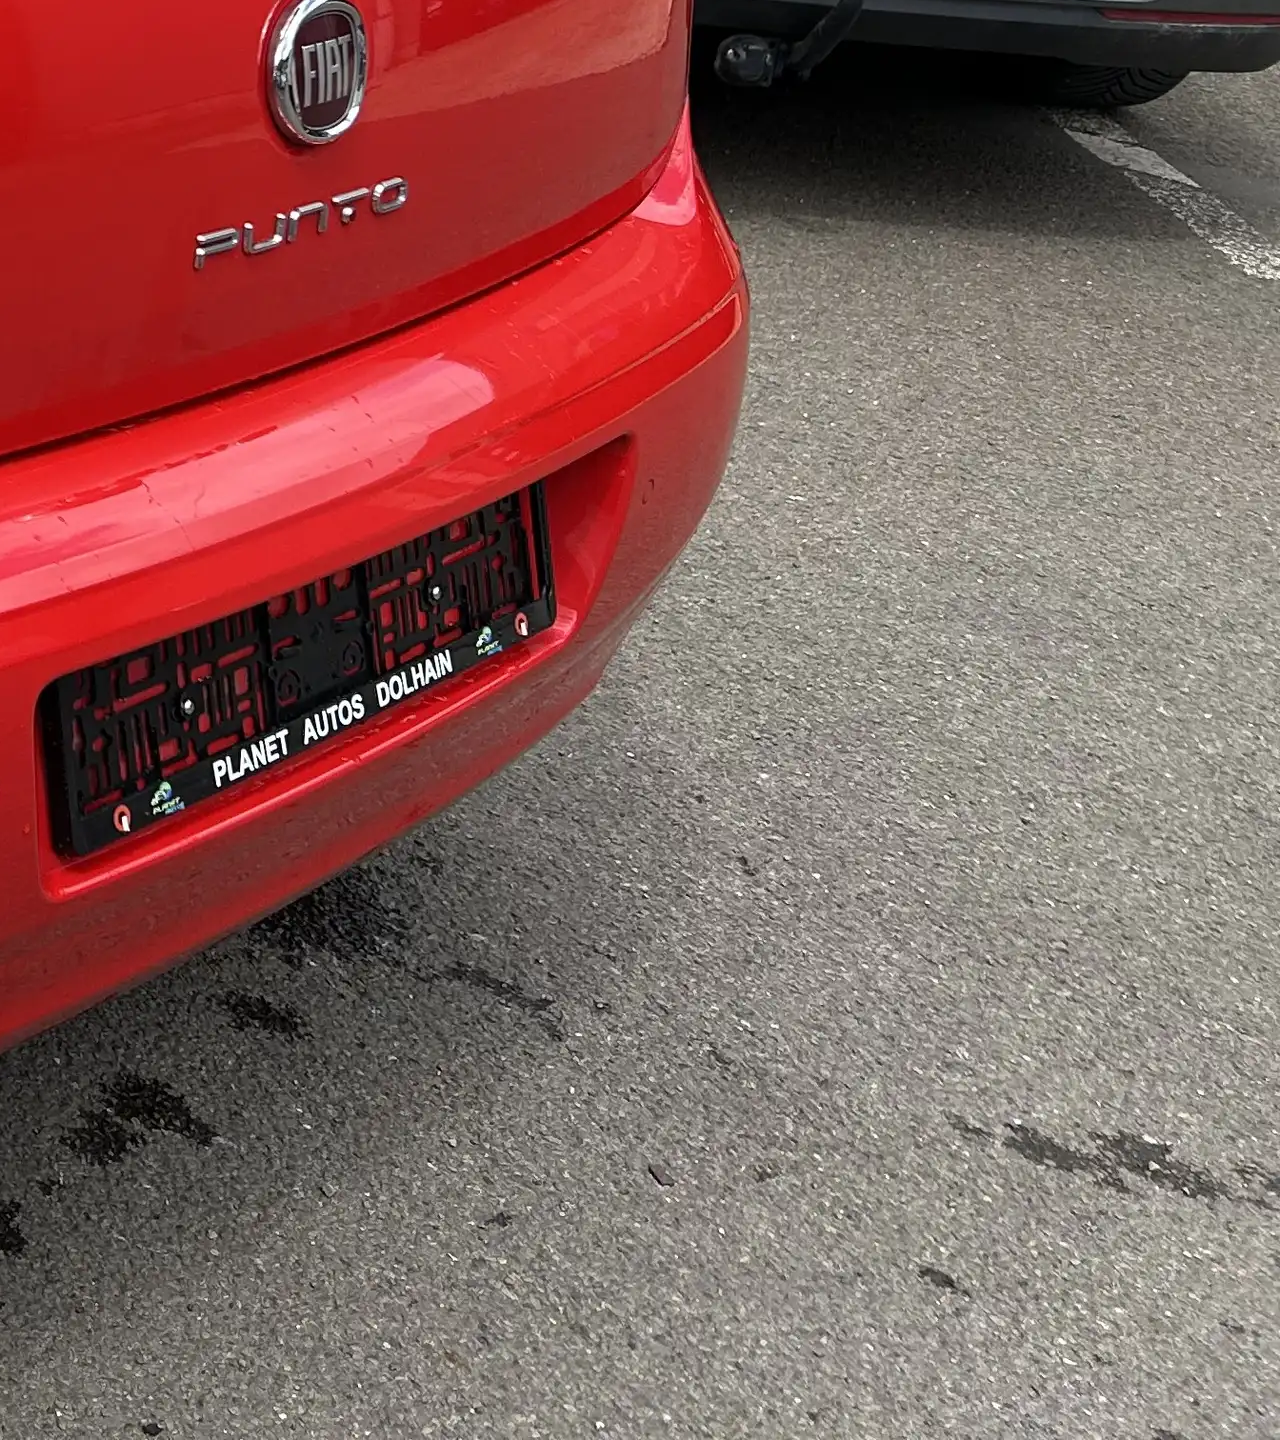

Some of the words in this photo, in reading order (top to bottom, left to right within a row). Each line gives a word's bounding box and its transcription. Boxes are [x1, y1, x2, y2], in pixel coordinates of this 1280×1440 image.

[301, 33, 352, 108] FIAT
[193, 176, 408, 270] PUNTO
[212, 728, 291, 788] PLANET
[303, 692, 366, 747] AUTOS
[375, 648, 454, 708] DOLHAIN
